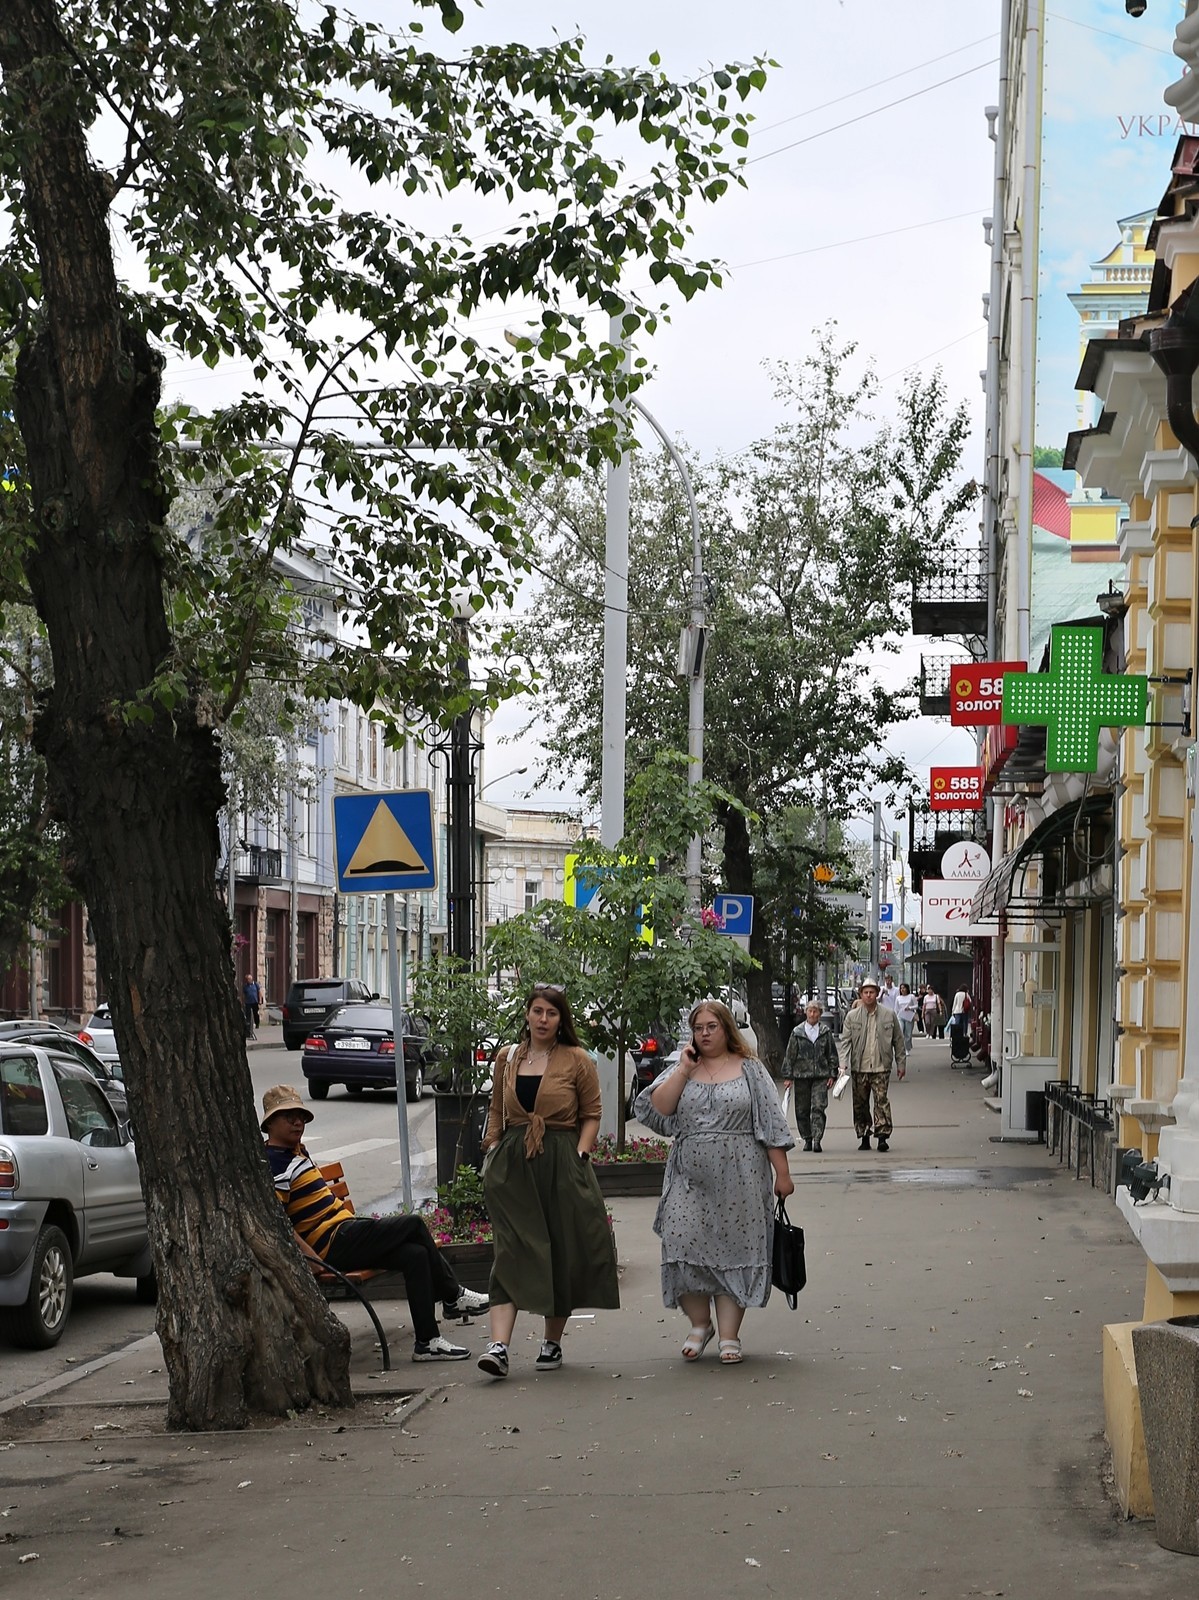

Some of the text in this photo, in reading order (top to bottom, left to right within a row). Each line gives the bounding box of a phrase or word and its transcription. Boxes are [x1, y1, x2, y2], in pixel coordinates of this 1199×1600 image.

[979, 678, 1003, 696] 58
[955, 699, 1002, 712] ЗОЛОТ
[950, 777, 979, 790] 585
[933, 788, 979, 800] ЗОЛОТОЙ
[951, 870, 981, 878] АЛМАЗ
[928, 898, 972, 906] ОПТИ
[722, 899, 743, 929] P
